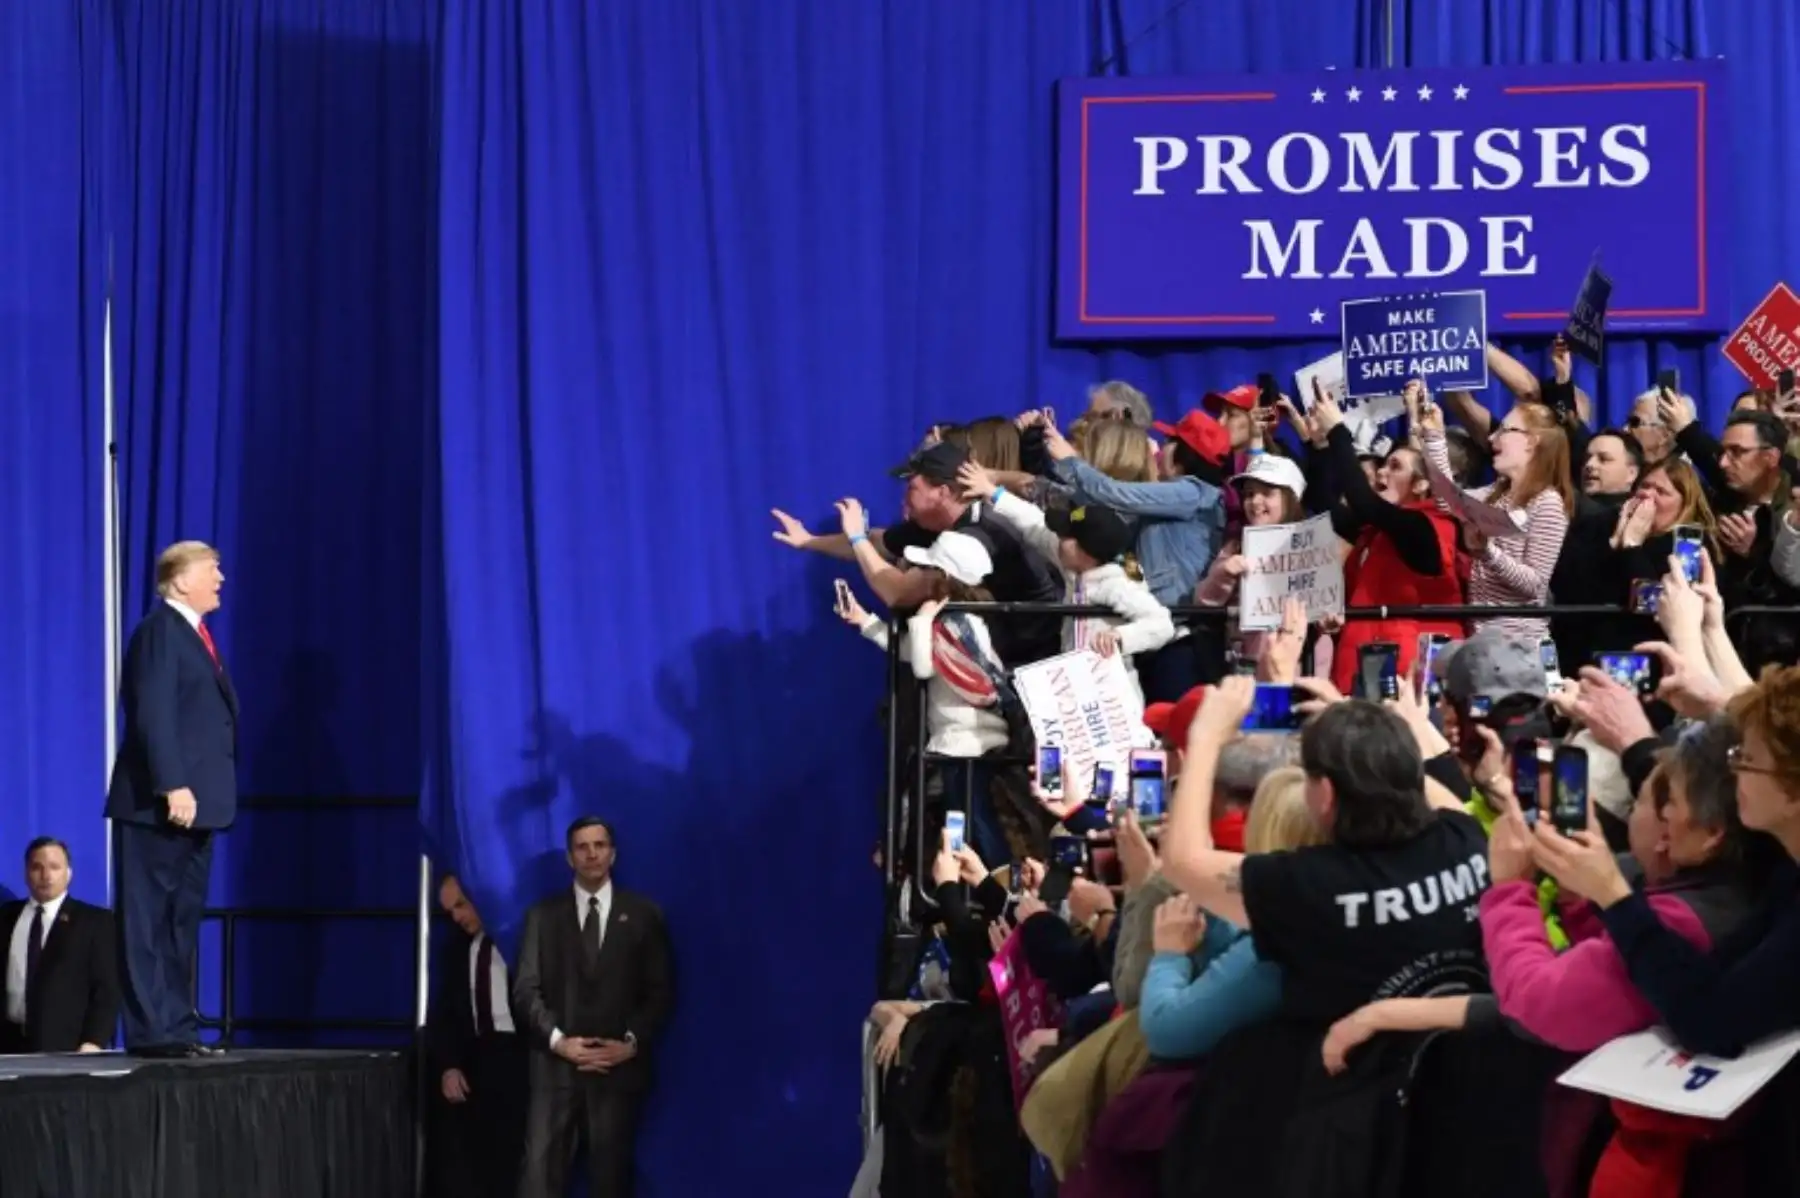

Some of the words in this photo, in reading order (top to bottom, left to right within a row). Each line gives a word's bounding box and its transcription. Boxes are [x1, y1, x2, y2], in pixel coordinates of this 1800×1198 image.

[1133, 124, 1650, 195] PROMISES
[1242, 215, 1537, 279] MADE
[1388, 308, 1435, 326] MAKE
[1349, 326, 1482, 358] AMERICA
[1748, 315, 1800, 369] AME
[1361, 360, 1404, 379] SAFE
[1408, 355, 1469, 377] AGAIN
[1291, 528, 1315, 550] BUY
[1287, 571, 1317, 592] HIRE
[1081, 701, 1111, 748] HIRE
[1335, 853, 1487, 928] TRUMP
